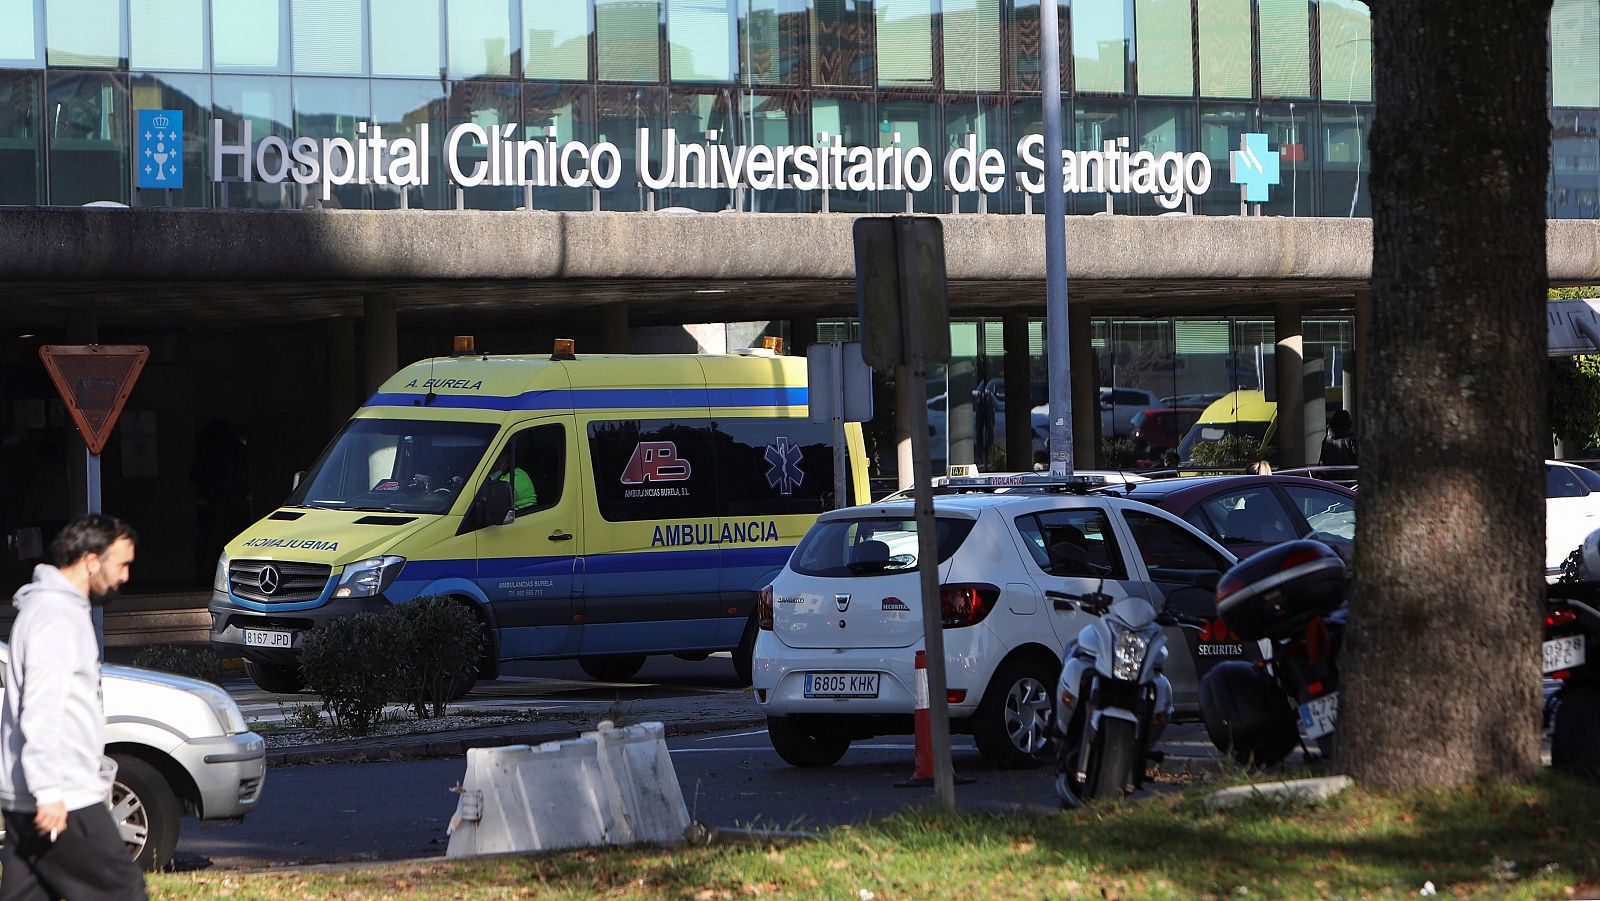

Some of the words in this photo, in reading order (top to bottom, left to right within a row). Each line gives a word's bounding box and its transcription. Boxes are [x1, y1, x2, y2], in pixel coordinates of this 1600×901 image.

[211, 118, 428, 200] Hospital
[445, 122, 622, 190] Clínico
[637, 128, 932, 192] Universitario
[945, 133, 1005, 193] de
[1016, 134, 1211, 209] Santiago
[404, 378, 418, 388] A.
[422, 378, 482, 390] BURELA
[624, 488, 660, 498] AMBULANCIAS
[651, 520, 779, 547] AMBULANCIA
[498, 580, 534, 589] AMBULANCIAS
[247, 632, 269, 646] 8167
[271, 634, 290, 647] JPD
[1198, 644, 1243, 656] SECURITAS
[814, 676, 846, 691] 6805
[850, 676, 875, 691] KHK
